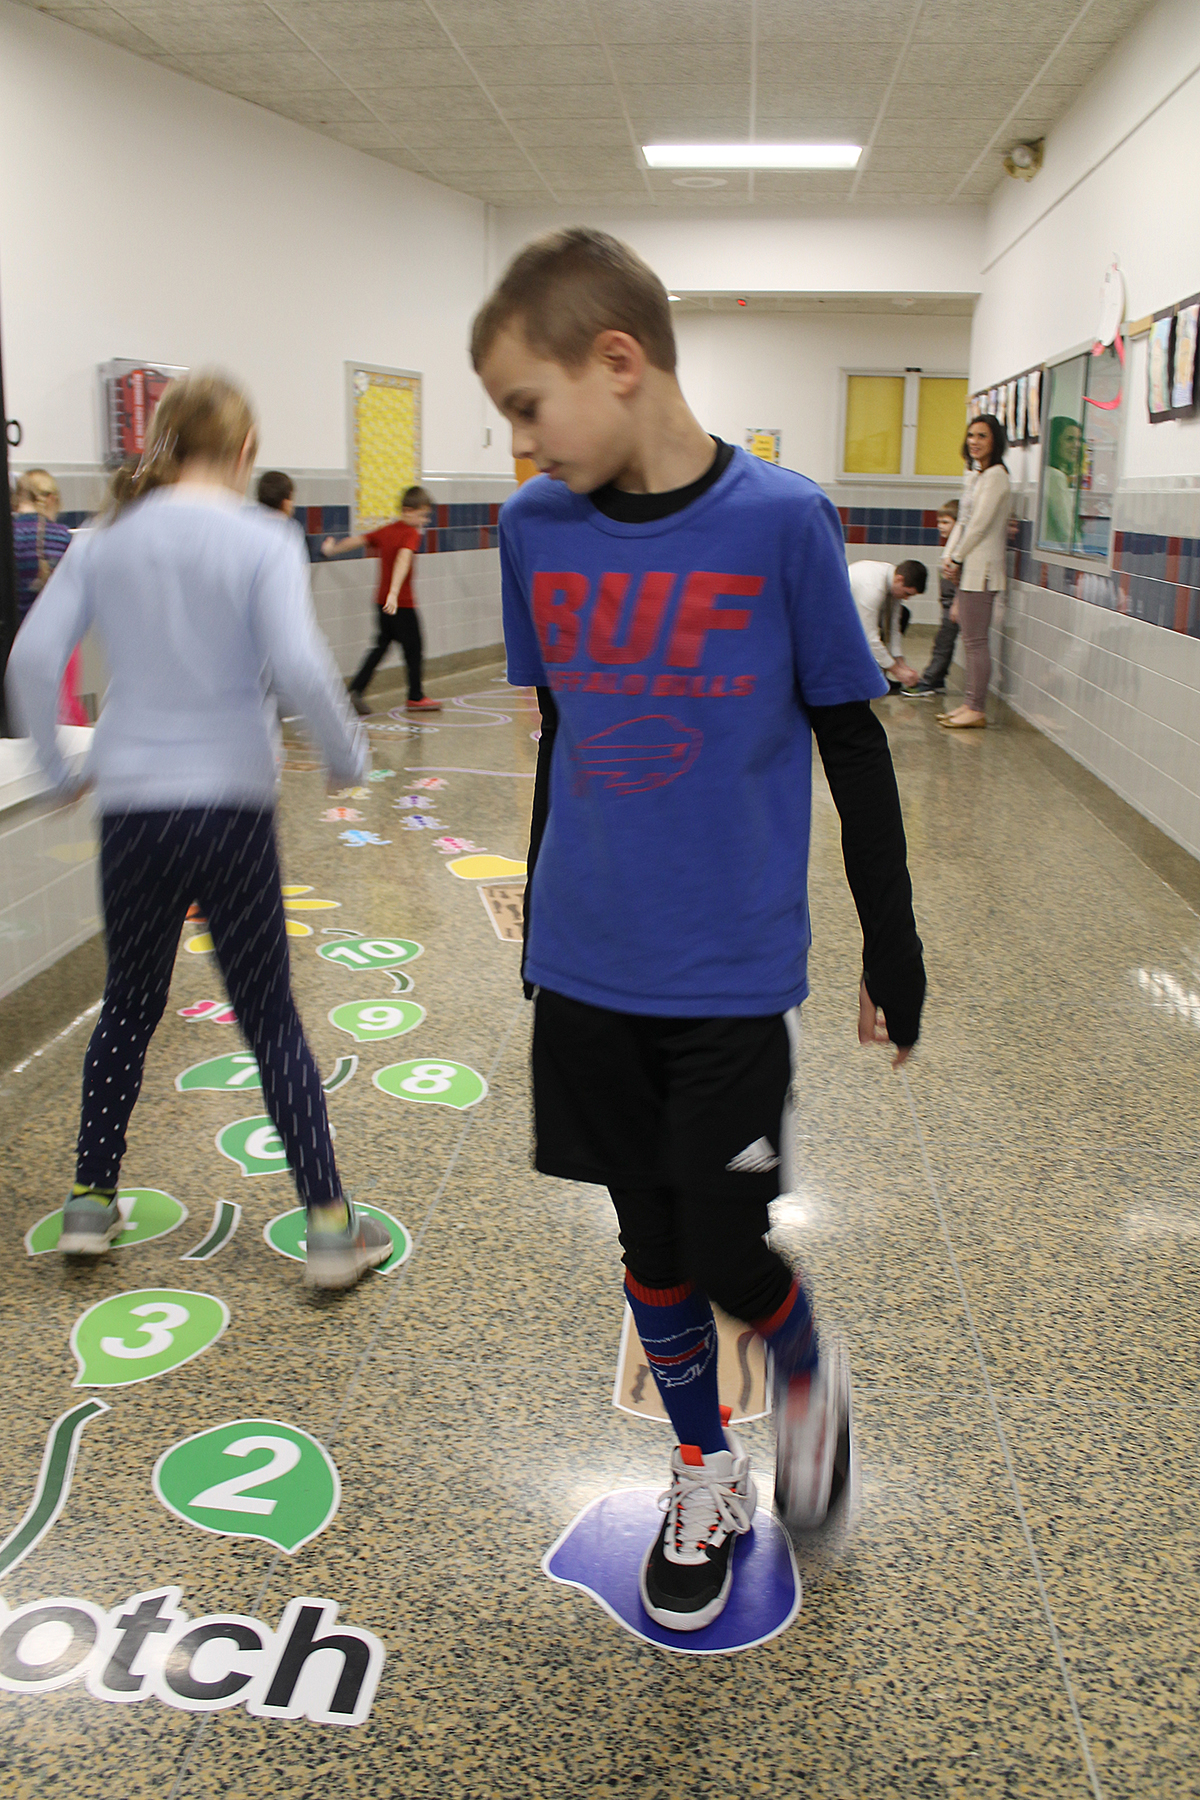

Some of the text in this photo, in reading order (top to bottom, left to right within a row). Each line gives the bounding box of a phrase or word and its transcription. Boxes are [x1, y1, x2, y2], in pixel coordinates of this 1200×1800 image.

[531, 571, 767, 668] BUF
[327, 940, 408, 964] 10
[357, 1006, 402, 1031] 9
[226, 1056, 262, 1085] 7
[401, 1064, 457, 1094] 8
[245, 1126, 287, 1159] 6
[101, 1303, 190, 1358] 3
[188, 1435, 301, 1515] 2
[0, 1594, 371, 1715] otch
